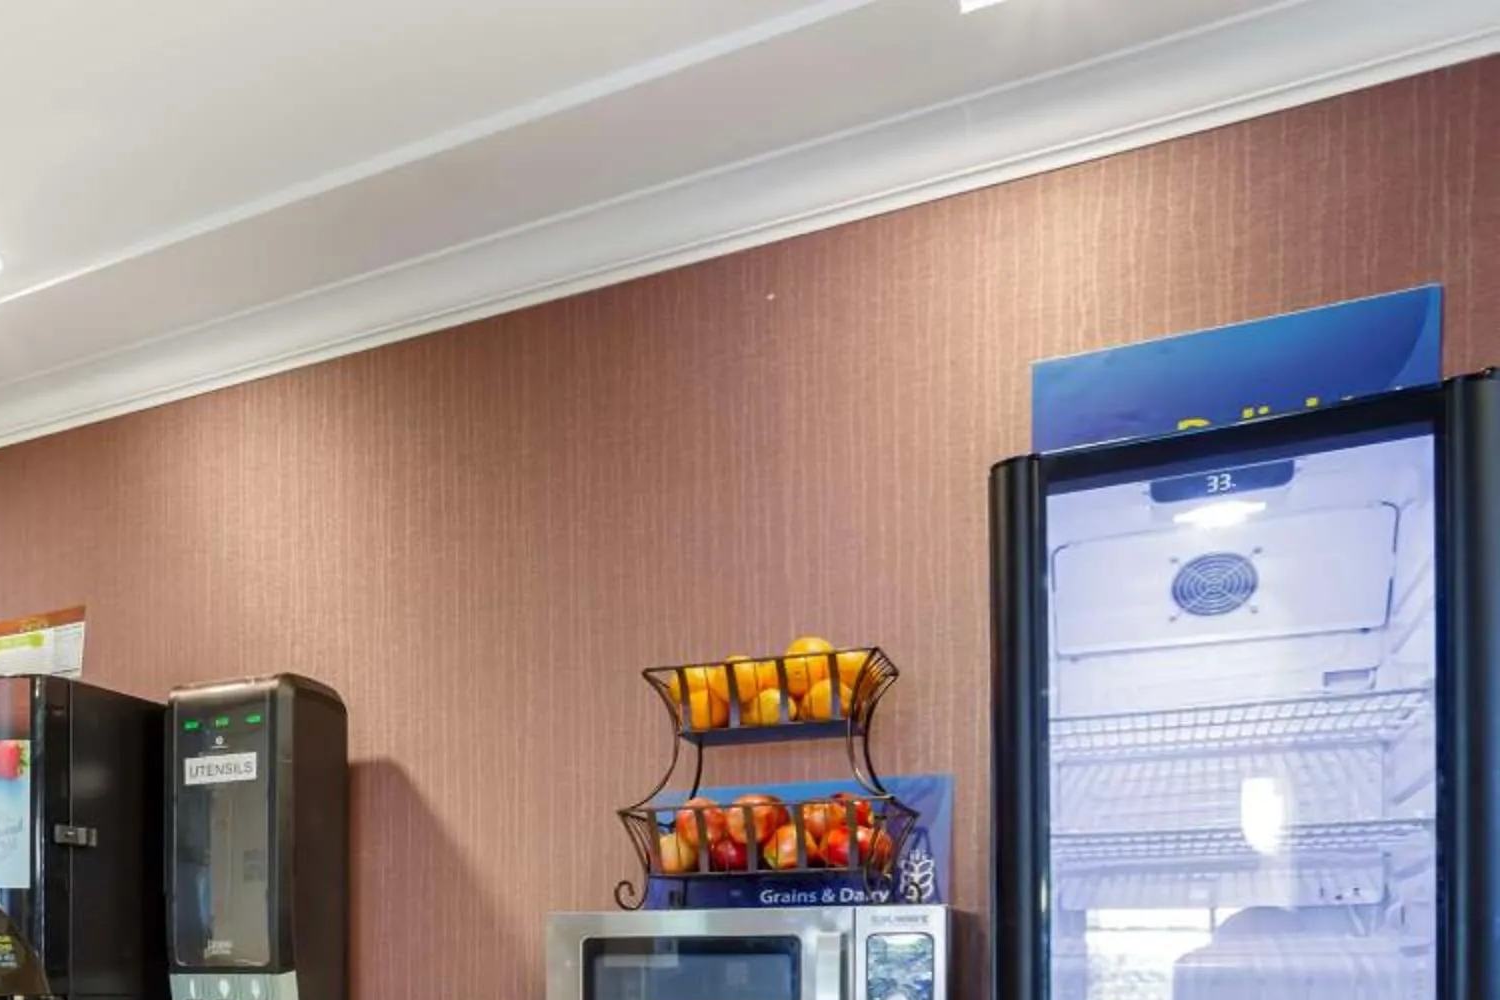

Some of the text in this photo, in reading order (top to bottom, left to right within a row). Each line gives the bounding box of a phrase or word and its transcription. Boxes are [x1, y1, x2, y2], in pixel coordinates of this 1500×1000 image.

[189, 760, 254, 779] UTENSILS
[759, 888, 817, 904] Grains
[821, 887, 836, 903] &
